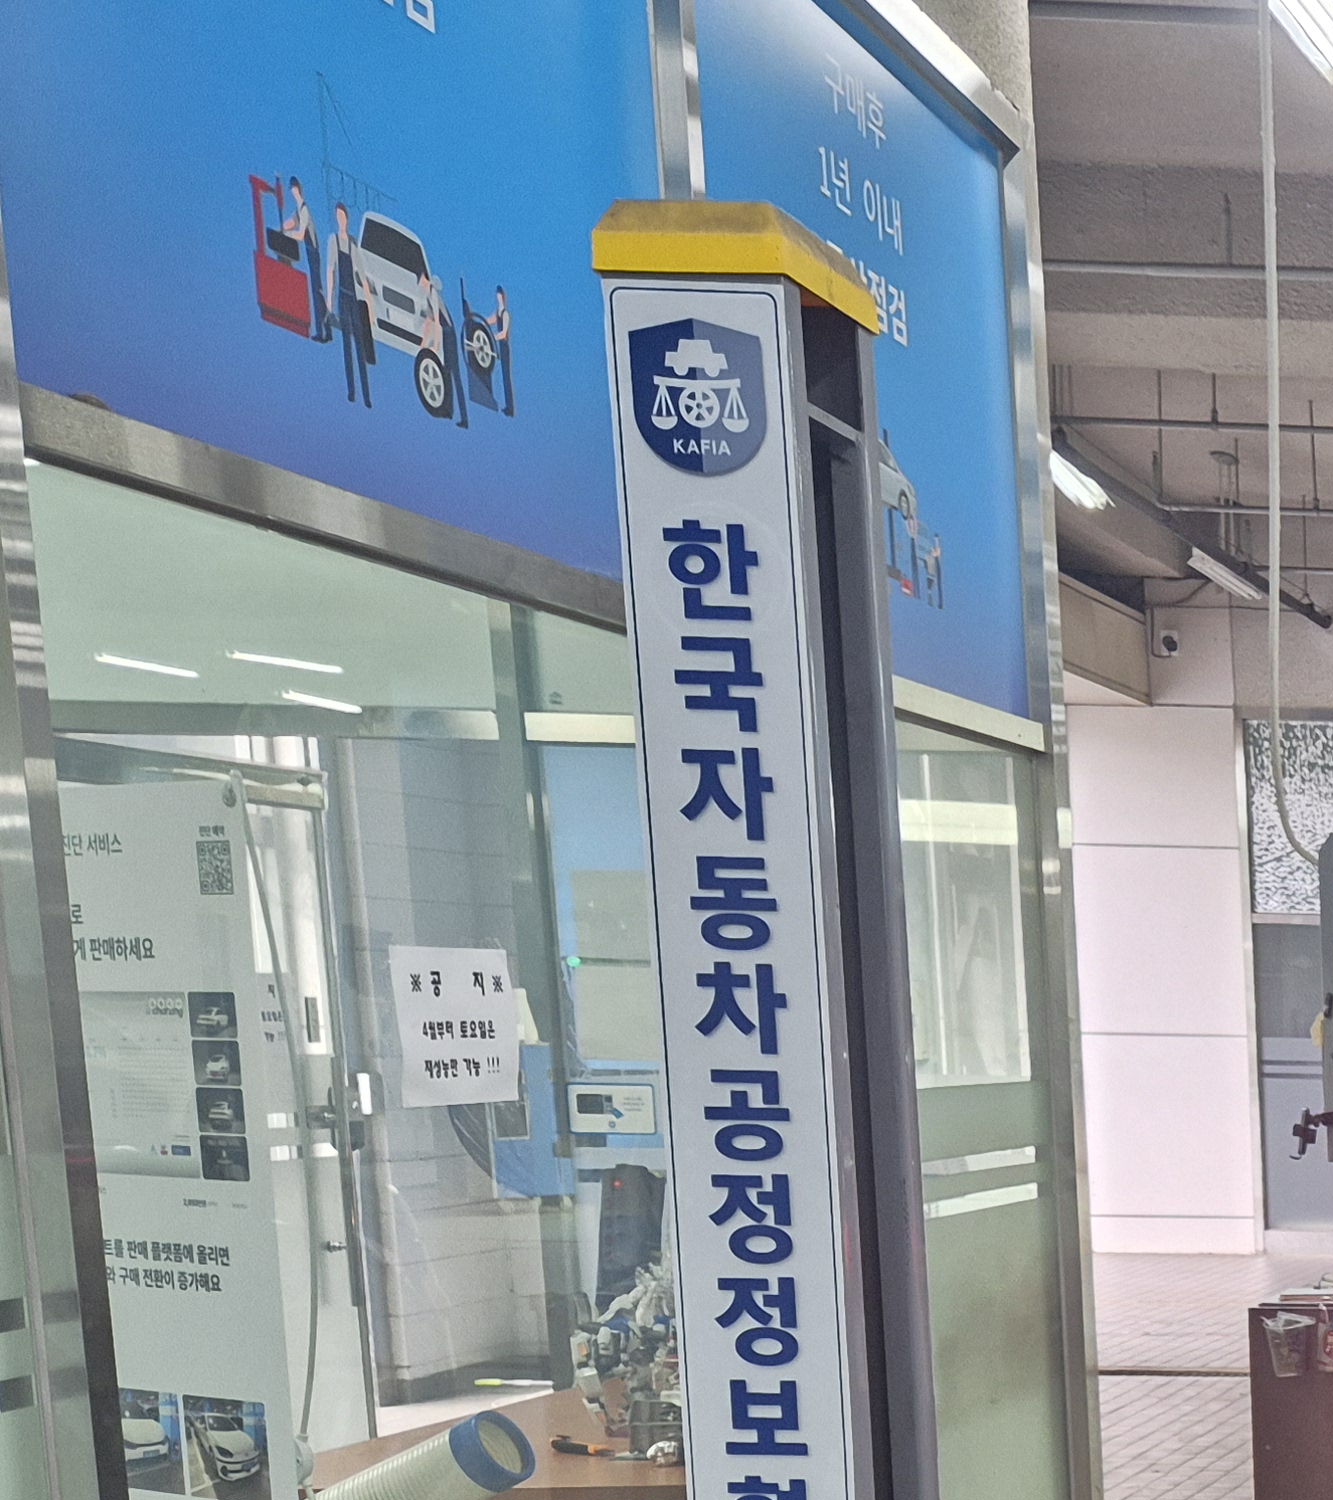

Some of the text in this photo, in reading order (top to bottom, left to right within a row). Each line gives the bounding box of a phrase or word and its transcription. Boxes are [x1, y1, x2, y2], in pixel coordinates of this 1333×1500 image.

[822, 53, 887, 149] 구매후
[818, 146, 904, 256] 1년 이내
[673, 438, 731, 456] KAFIA
[86, 833, 123, 856] 서비스
[89, 936, 155, 961] 판매하세요
[422, 1020, 496, 1040] 4월부터 토요일은
[463, 1058, 482, 1077] 가능
[126, 1240, 149, 1260] 판매
[151, 1241, 194, 1263] 플랫폼에
[196, 1244, 231, 1267] 올리면
[118, 1266, 141, 1286] 구매
[142, 1268, 175, 1289] 전환이
[177, 1271, 222, 1292] 증가해요
